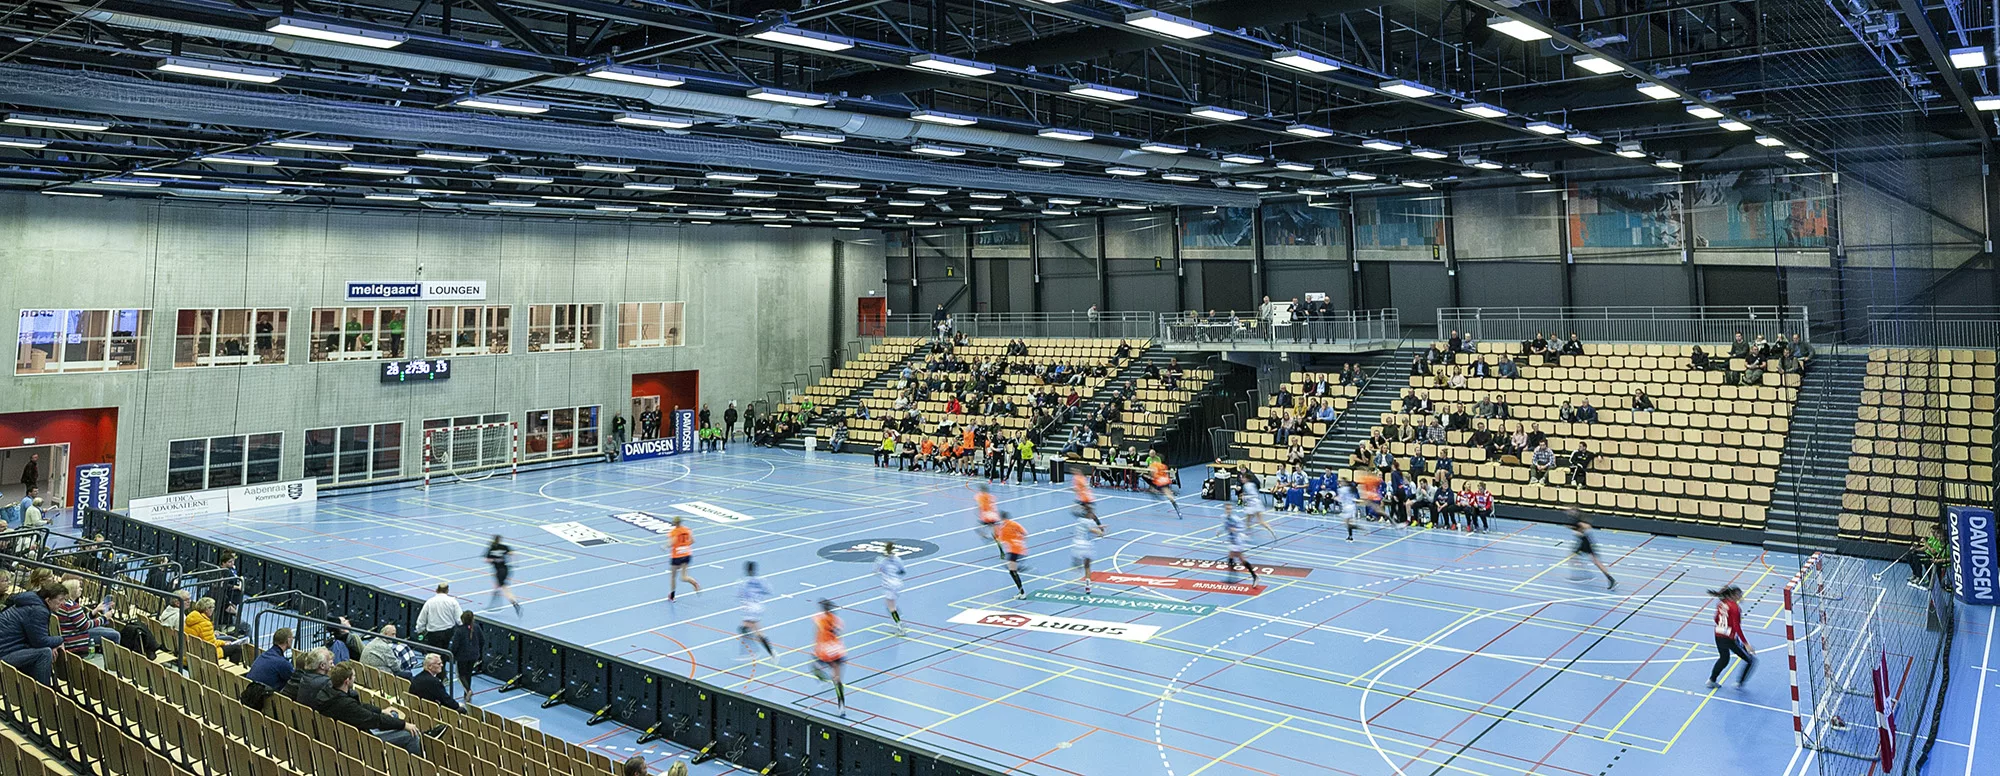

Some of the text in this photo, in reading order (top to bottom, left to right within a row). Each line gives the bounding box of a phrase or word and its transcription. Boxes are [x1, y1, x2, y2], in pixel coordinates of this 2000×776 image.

[351, 284, 418, 296] meldgaard
[429, 286, 480, 295] LOUNGEN
[386, 365, 400, 375] 28
[435, 363, 448, 373] 13
[682, 412, 692, 451] DAVIDSEN
[624, 439, 674, 456] DAVIDSEN
[98, 467, 109, 511] DAVIDS
[243, 484, 287, 495] Aabenraa
[165, 494, 195, 503] JUDICA
[255, 493, 286, 502] Kommune
[151, 500, 209, 512] ADVOKATERNE
[1950, 512, 1963, 596] DAVIDSEN
[1969, 516, 1993, 600] DAVIDSEN
[1030, 620, 1128, 635] SPORT
